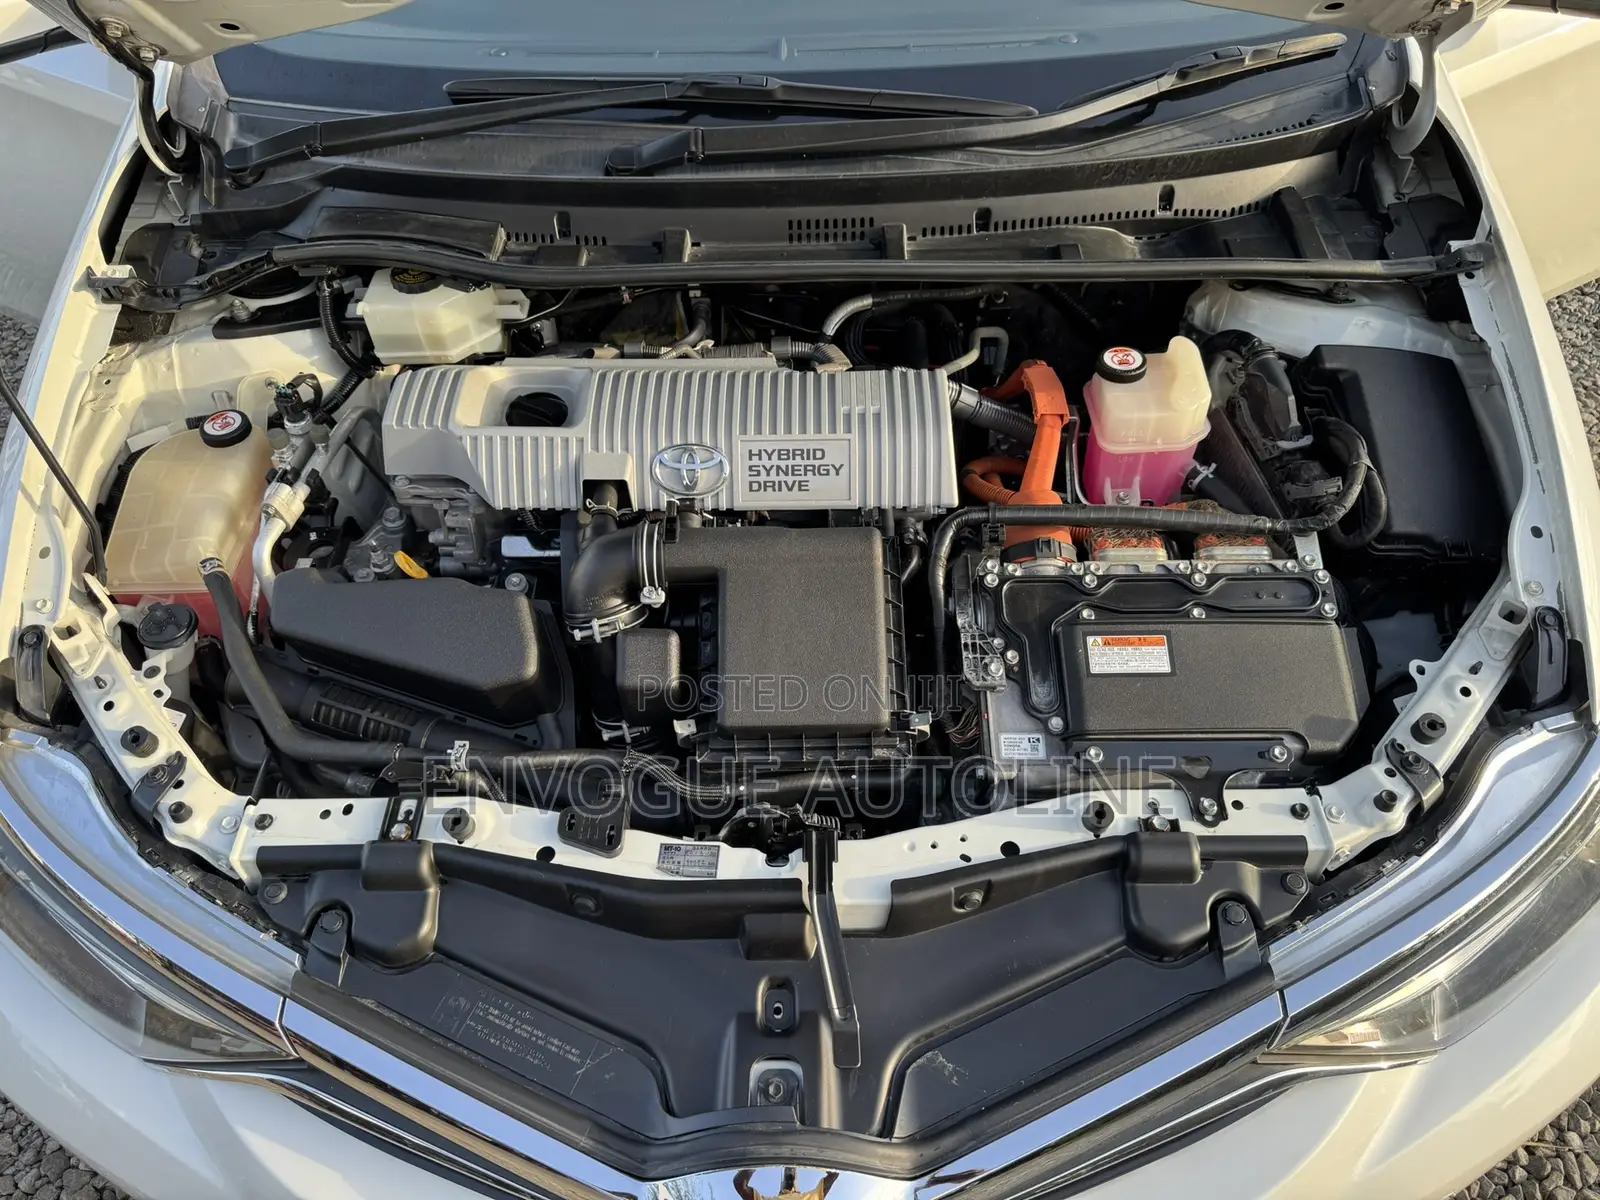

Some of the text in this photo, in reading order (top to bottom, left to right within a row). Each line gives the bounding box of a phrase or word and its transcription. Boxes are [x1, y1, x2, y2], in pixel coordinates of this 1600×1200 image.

[748, 448, 826, 461] HYBRID
[748, 464, 845, 477] SYNERGY
[748, 480, 810, 493] DRIVE
